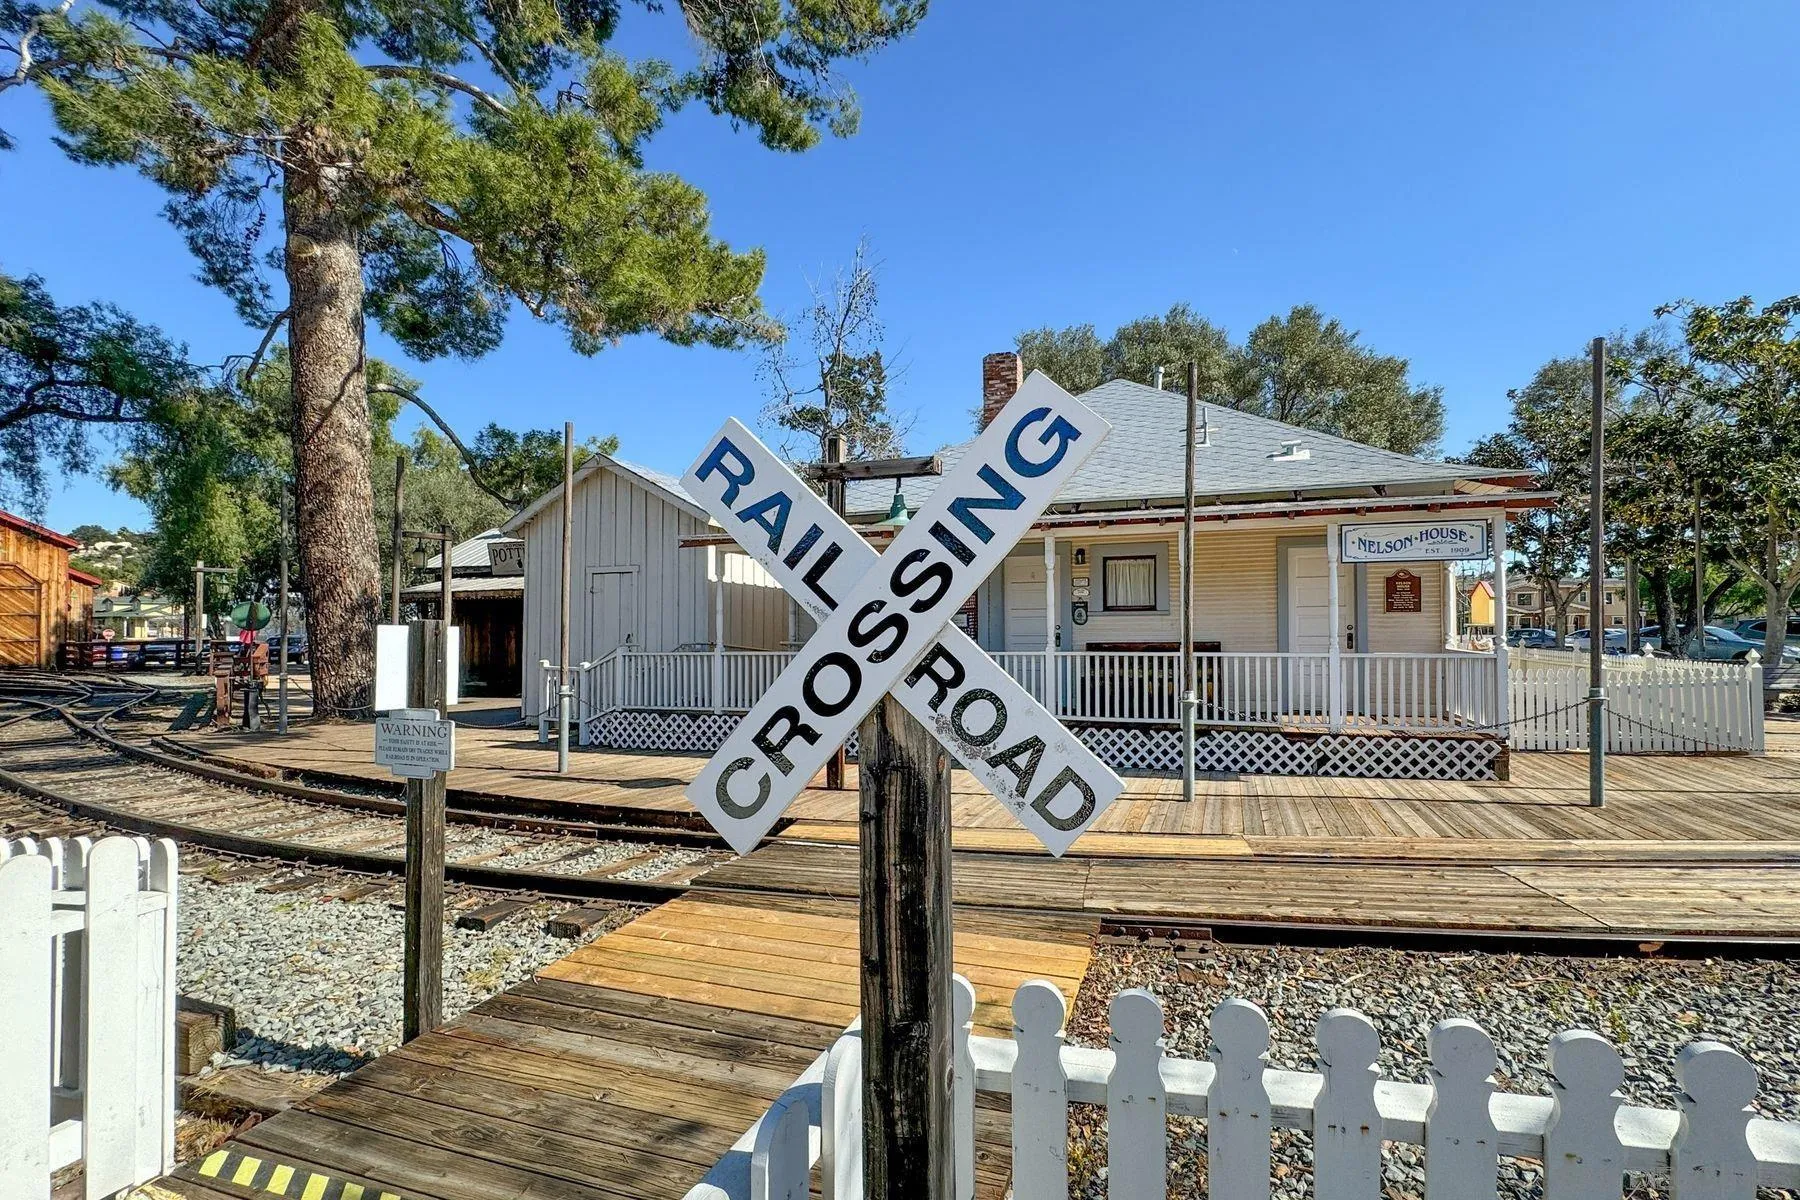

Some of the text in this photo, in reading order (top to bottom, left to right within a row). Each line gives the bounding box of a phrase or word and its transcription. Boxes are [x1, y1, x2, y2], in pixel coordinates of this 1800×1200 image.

[694, 435, 1097, 832] RAIL ROAD
[715, 406, 1083, 820] CROSSING
[1357, 527, 1468, 554] NELSON HOUSE
[381, 722, 447, 739] WARNING
